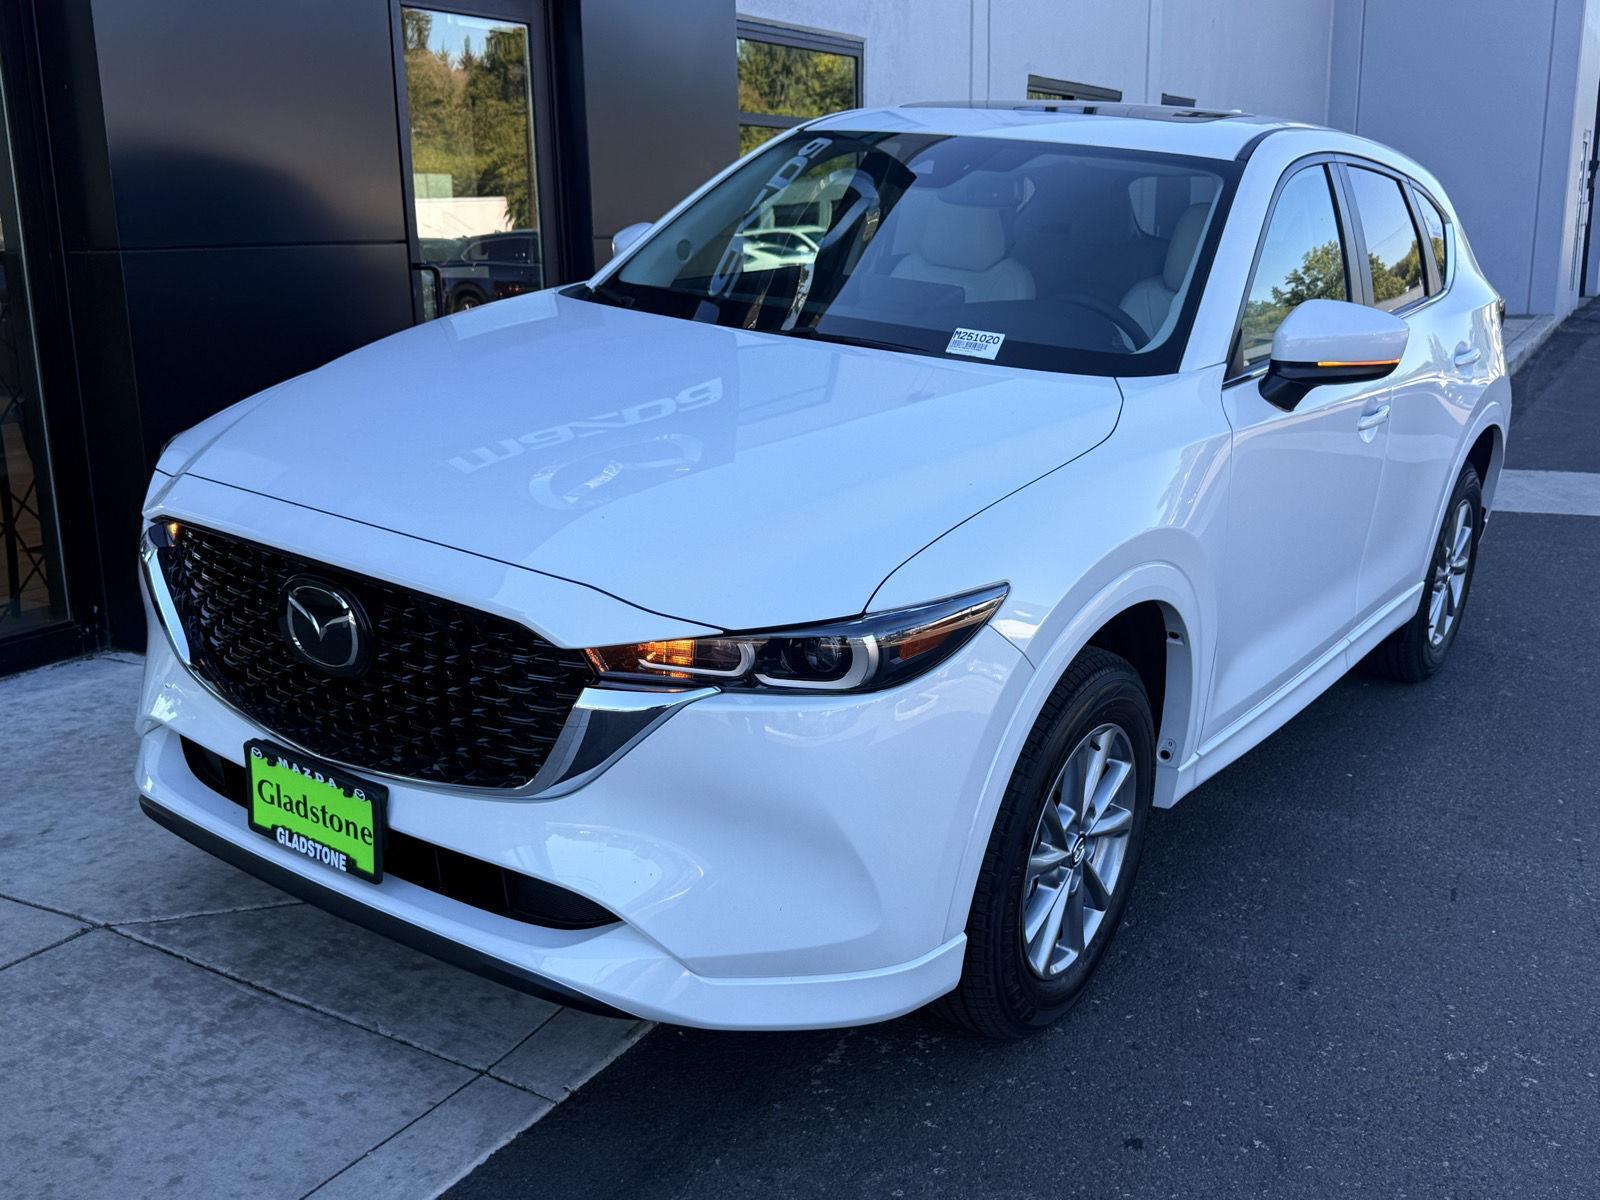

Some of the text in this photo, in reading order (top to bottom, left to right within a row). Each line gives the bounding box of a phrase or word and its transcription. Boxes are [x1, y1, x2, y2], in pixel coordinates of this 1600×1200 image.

[953, 331, 1001, 354] M251020
[278, 757, 337, 788] MAZDA
[257, 779, 372, 845] Gladstone
[276, 827, 347, 871] GLADSTONE
